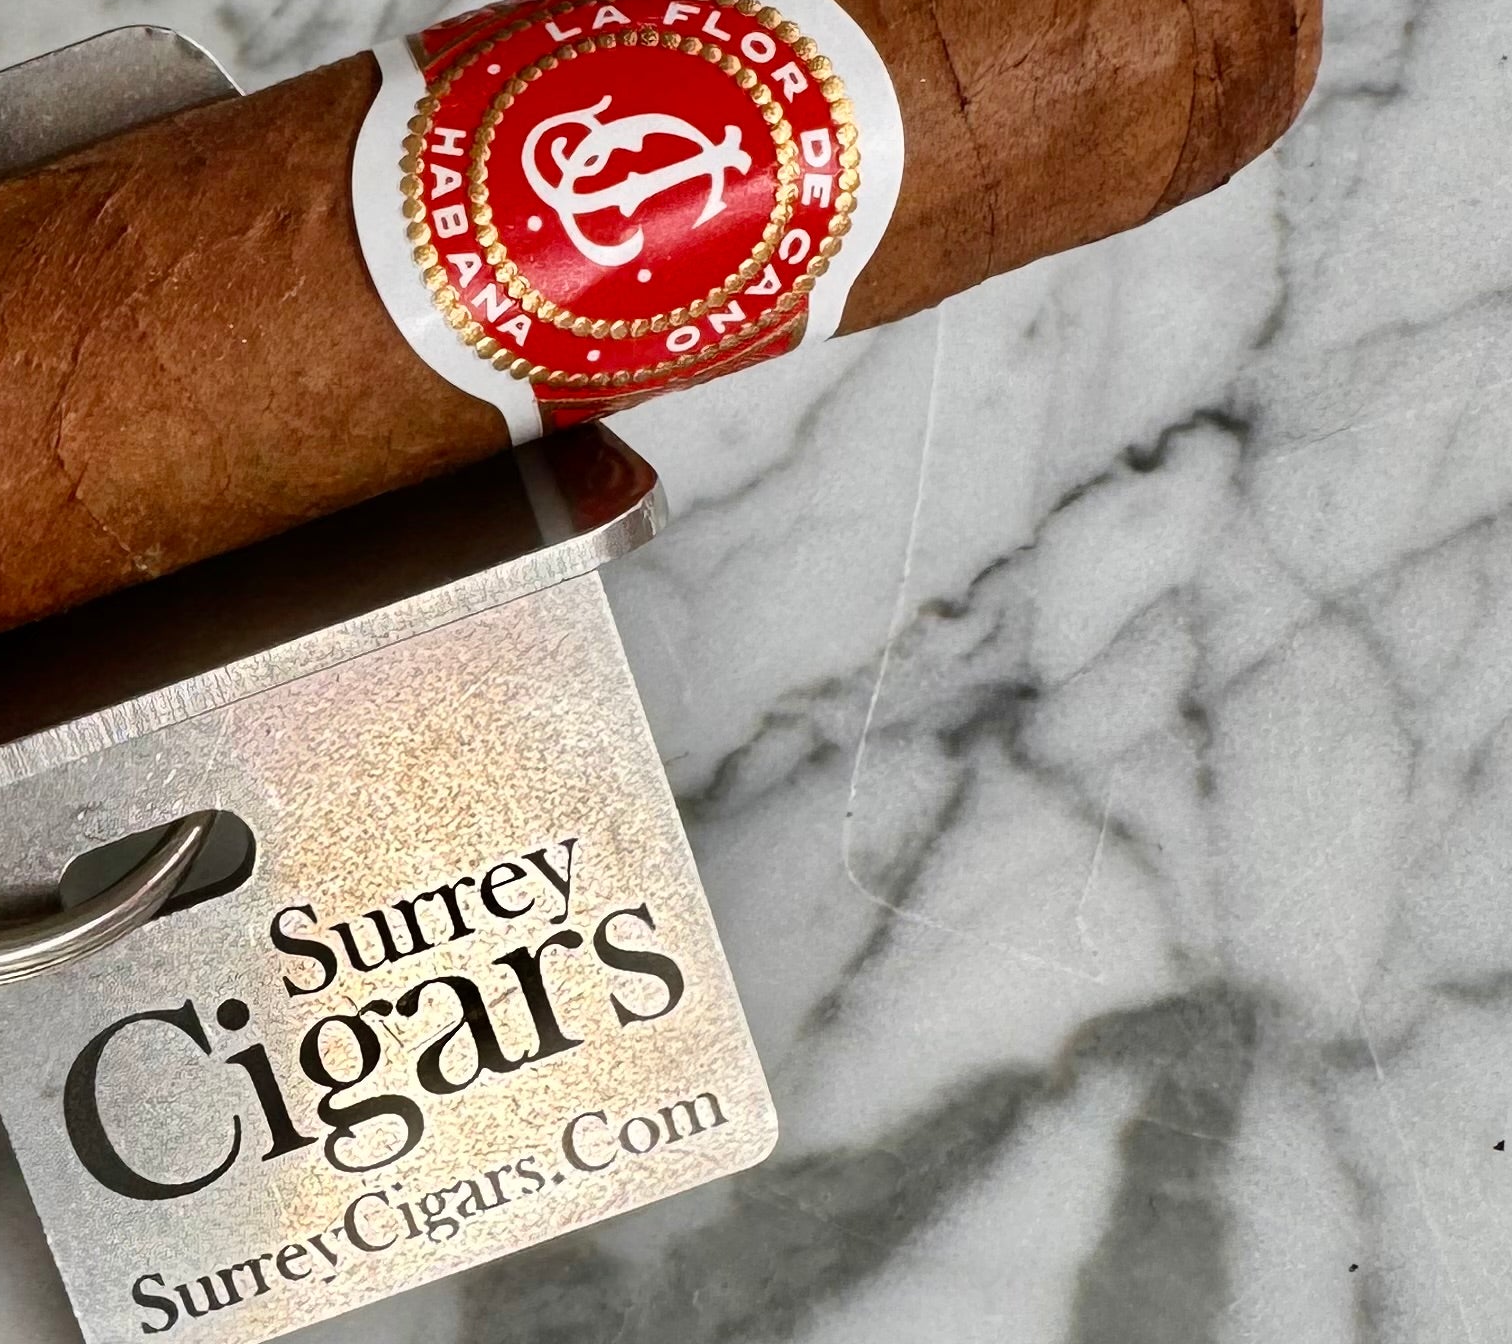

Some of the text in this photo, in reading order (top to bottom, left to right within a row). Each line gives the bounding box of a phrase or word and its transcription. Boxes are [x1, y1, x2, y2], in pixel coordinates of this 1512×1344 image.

[429, 126, 532, 347] HABANA
[544, 0, 833, 354] LA FLOR DE CANO
[268, 837, 580, 998] Surrey
[62, 902, 687, 1202] Cigars
[130, 1090, 729, 1336] SurreyCigars.Com
